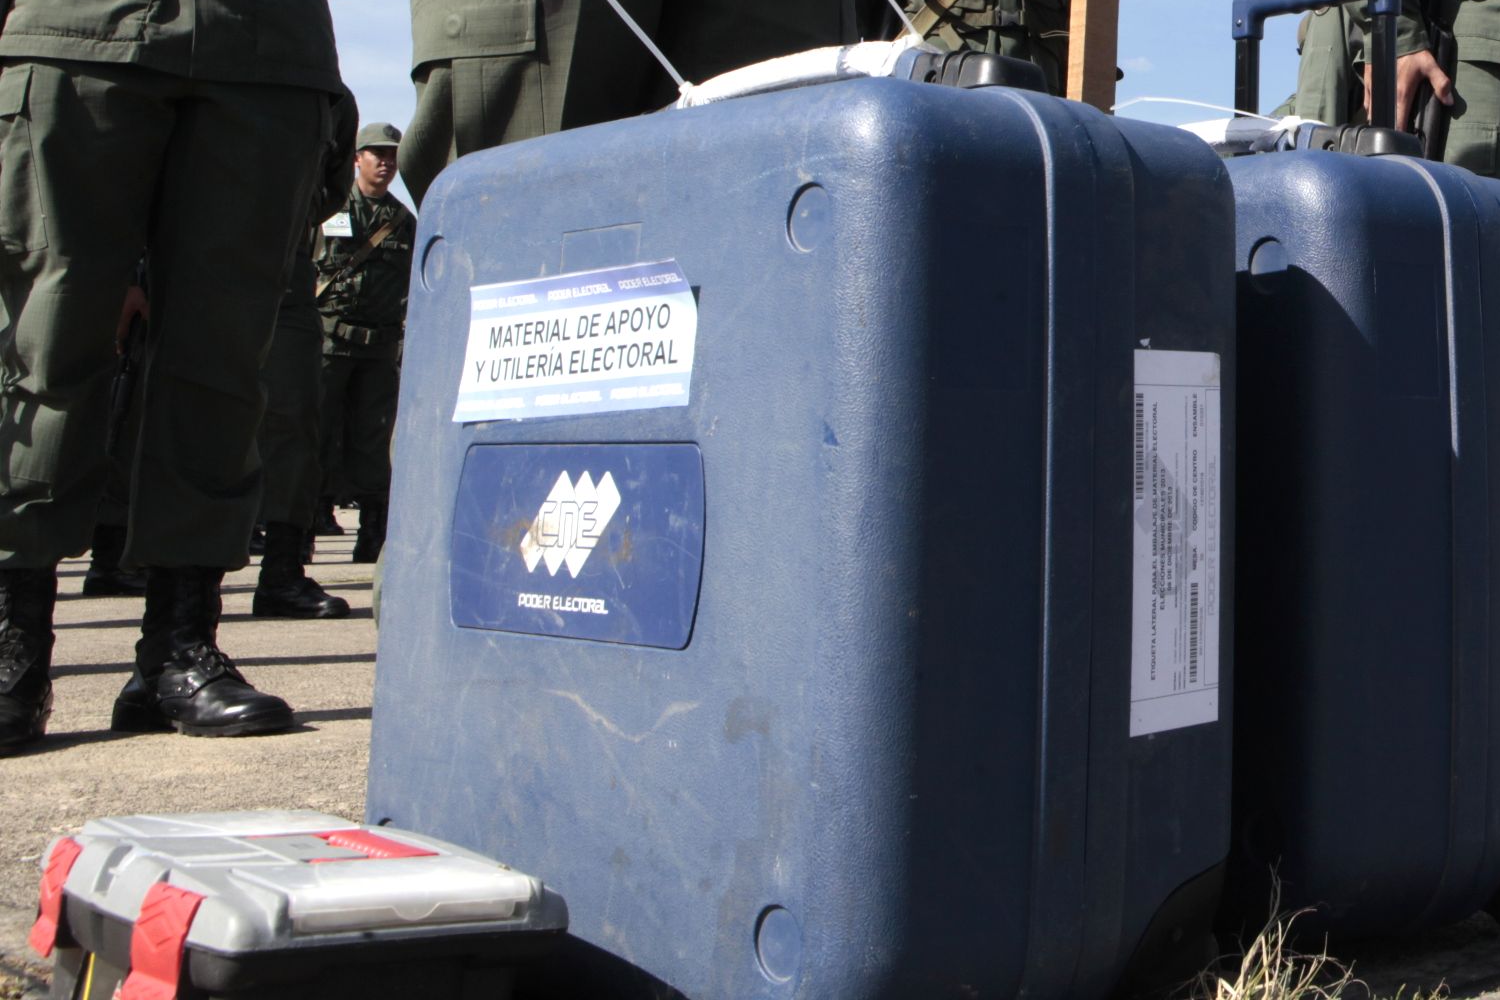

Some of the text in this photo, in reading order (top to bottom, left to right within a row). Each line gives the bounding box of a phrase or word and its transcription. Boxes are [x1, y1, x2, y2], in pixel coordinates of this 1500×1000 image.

[643, 273, 682, 287] ELECTORAL
[489, 303, 670, 350] MATERIAL DE APOYO
[476, 340, 678, 382] Y UTILERÍA ELECTORAL
[518, 593, 608, 614] PODER ELECTORAL
